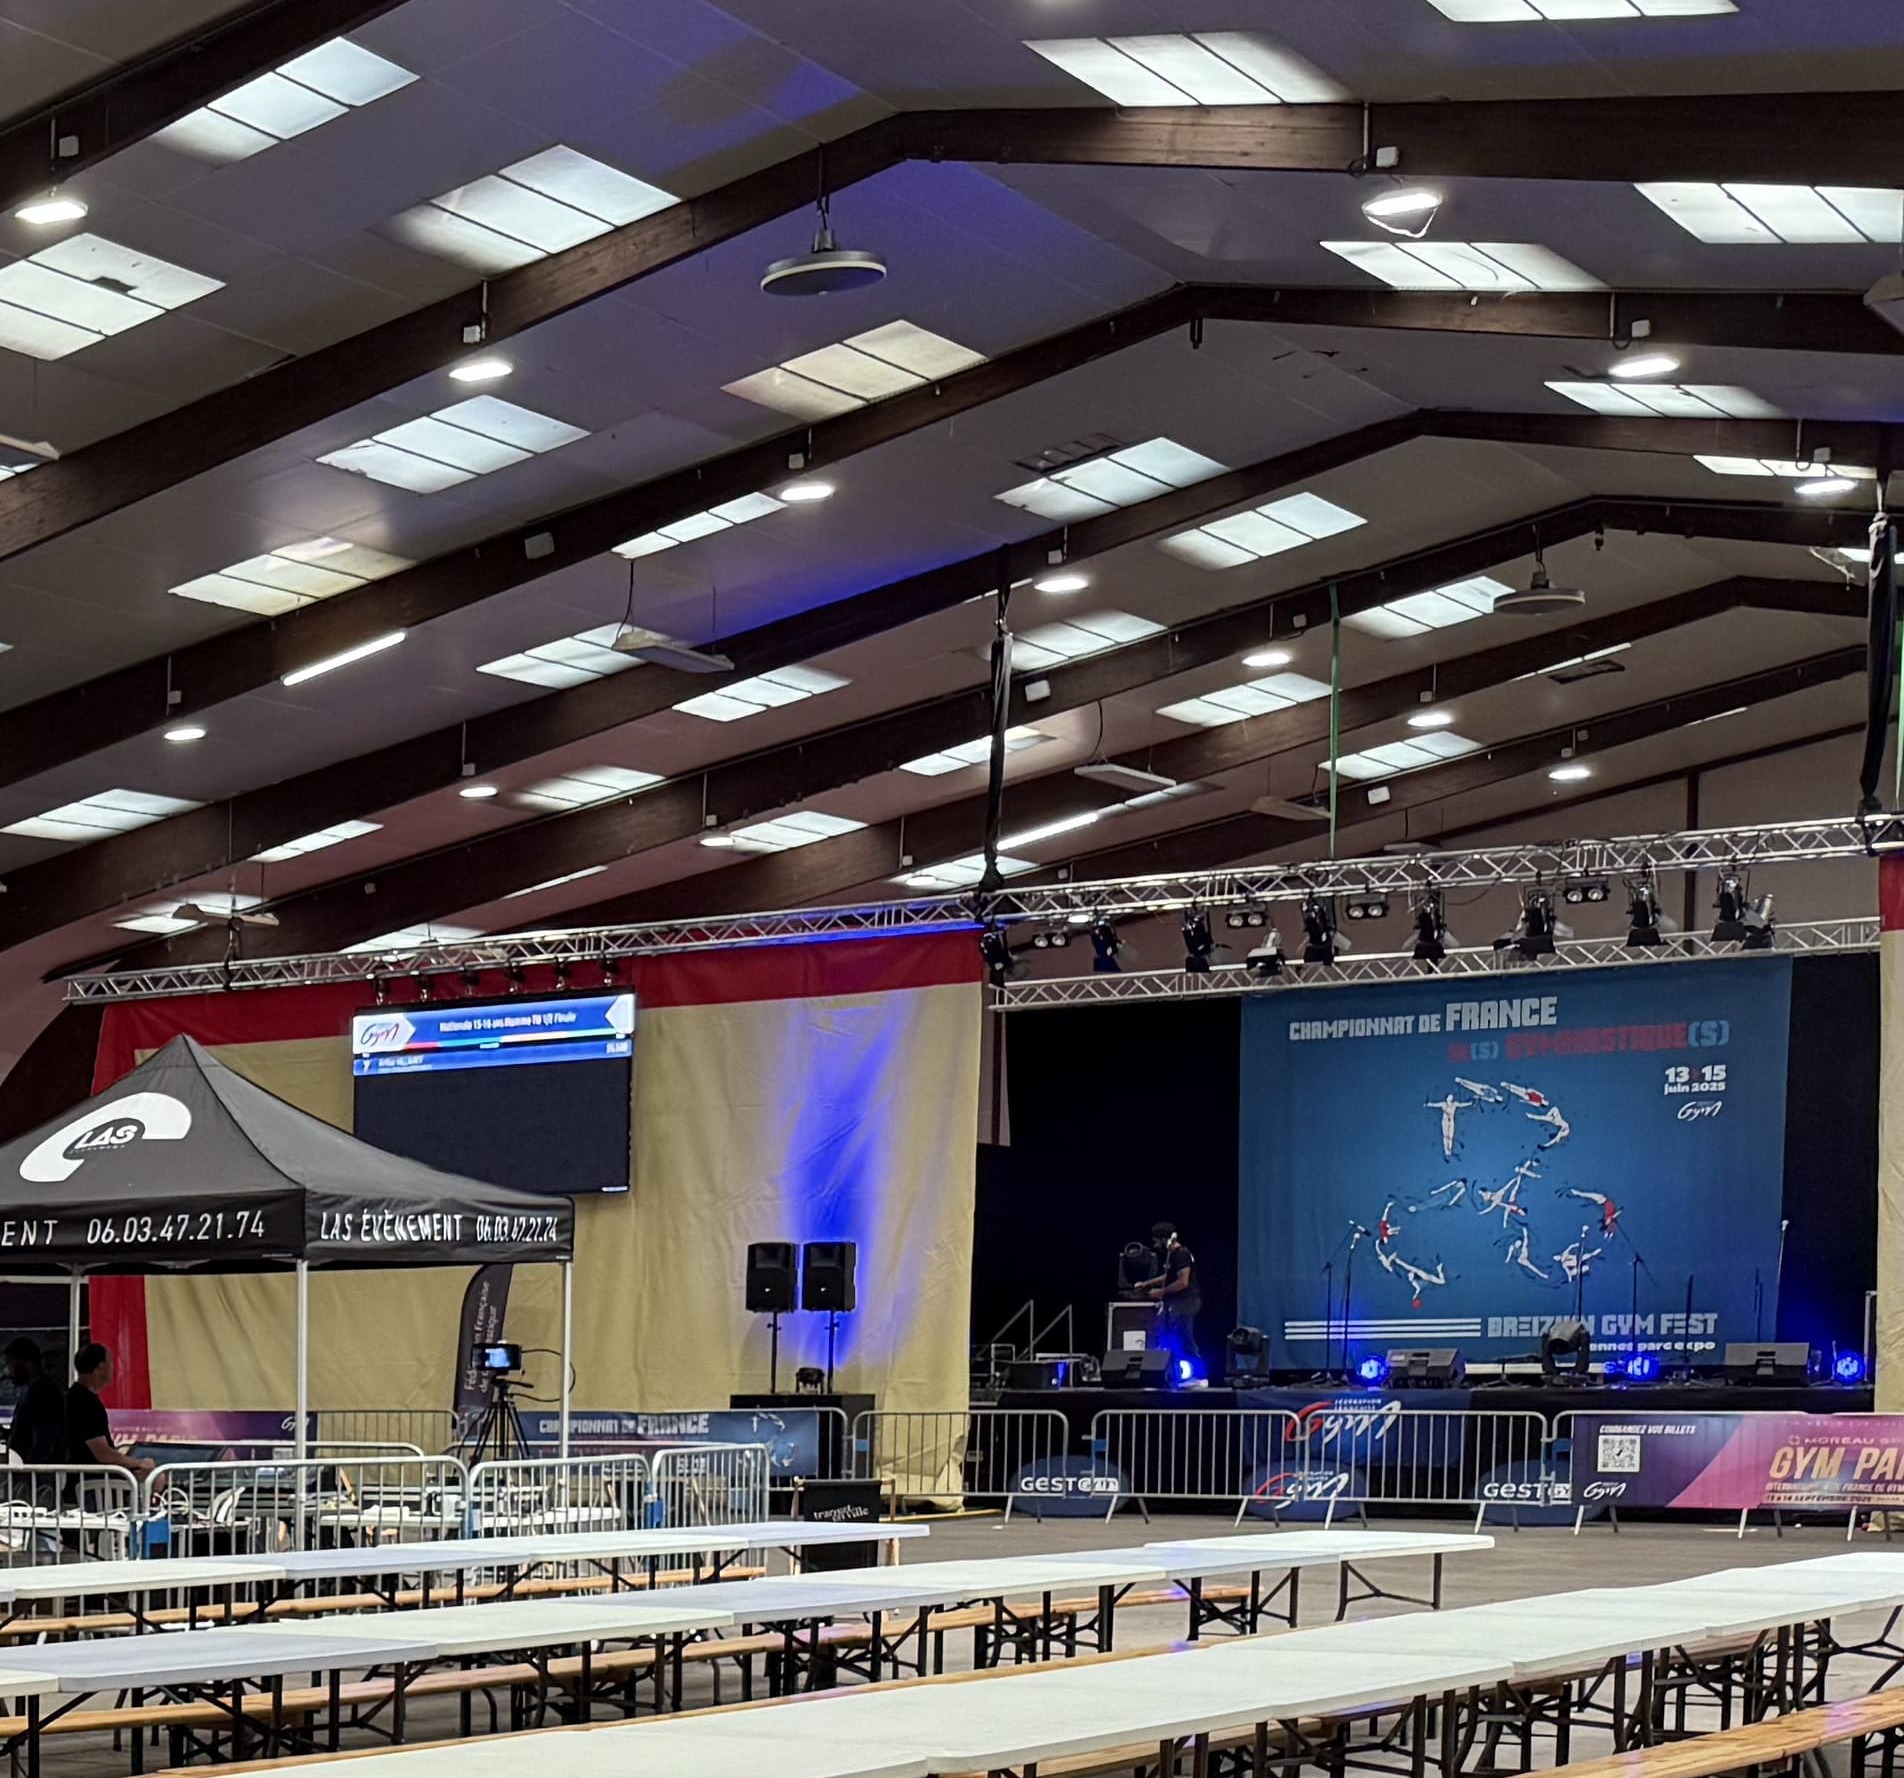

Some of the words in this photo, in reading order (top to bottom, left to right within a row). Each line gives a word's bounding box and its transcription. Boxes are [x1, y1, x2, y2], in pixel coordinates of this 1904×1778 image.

[1289, 1015, 1415, 1041] CHAMPIONNAT
[1418, 1013, 1442, 1034] DE
[1445, 996, 1558, 1031] FRANCE
[1665, 1066, 1690, 1084] 13
[1701, 1065, 1727, 1082] 15
[1691, 1081, 1727, 1093] 2025
[74, 1124, 138, 1149] LAS
[86, 1209, 265, 1245] 06.03.47.21.74
[320, 1211, 353, 1241] LAS
[360, 1208, 464, 1242] ÉVÈNEMENT
[1601, 1313, 1654, 1336] GYM
[1659, 1312, 1718, 1335] FEST
[1589, 1341, 1634, 1352] ennes
[637, 1413, 710, 1435] FRANCE
[1804, 1437, 1875, 1445] MOREAU
[1768, 1446, 1846, 1480] GYM
